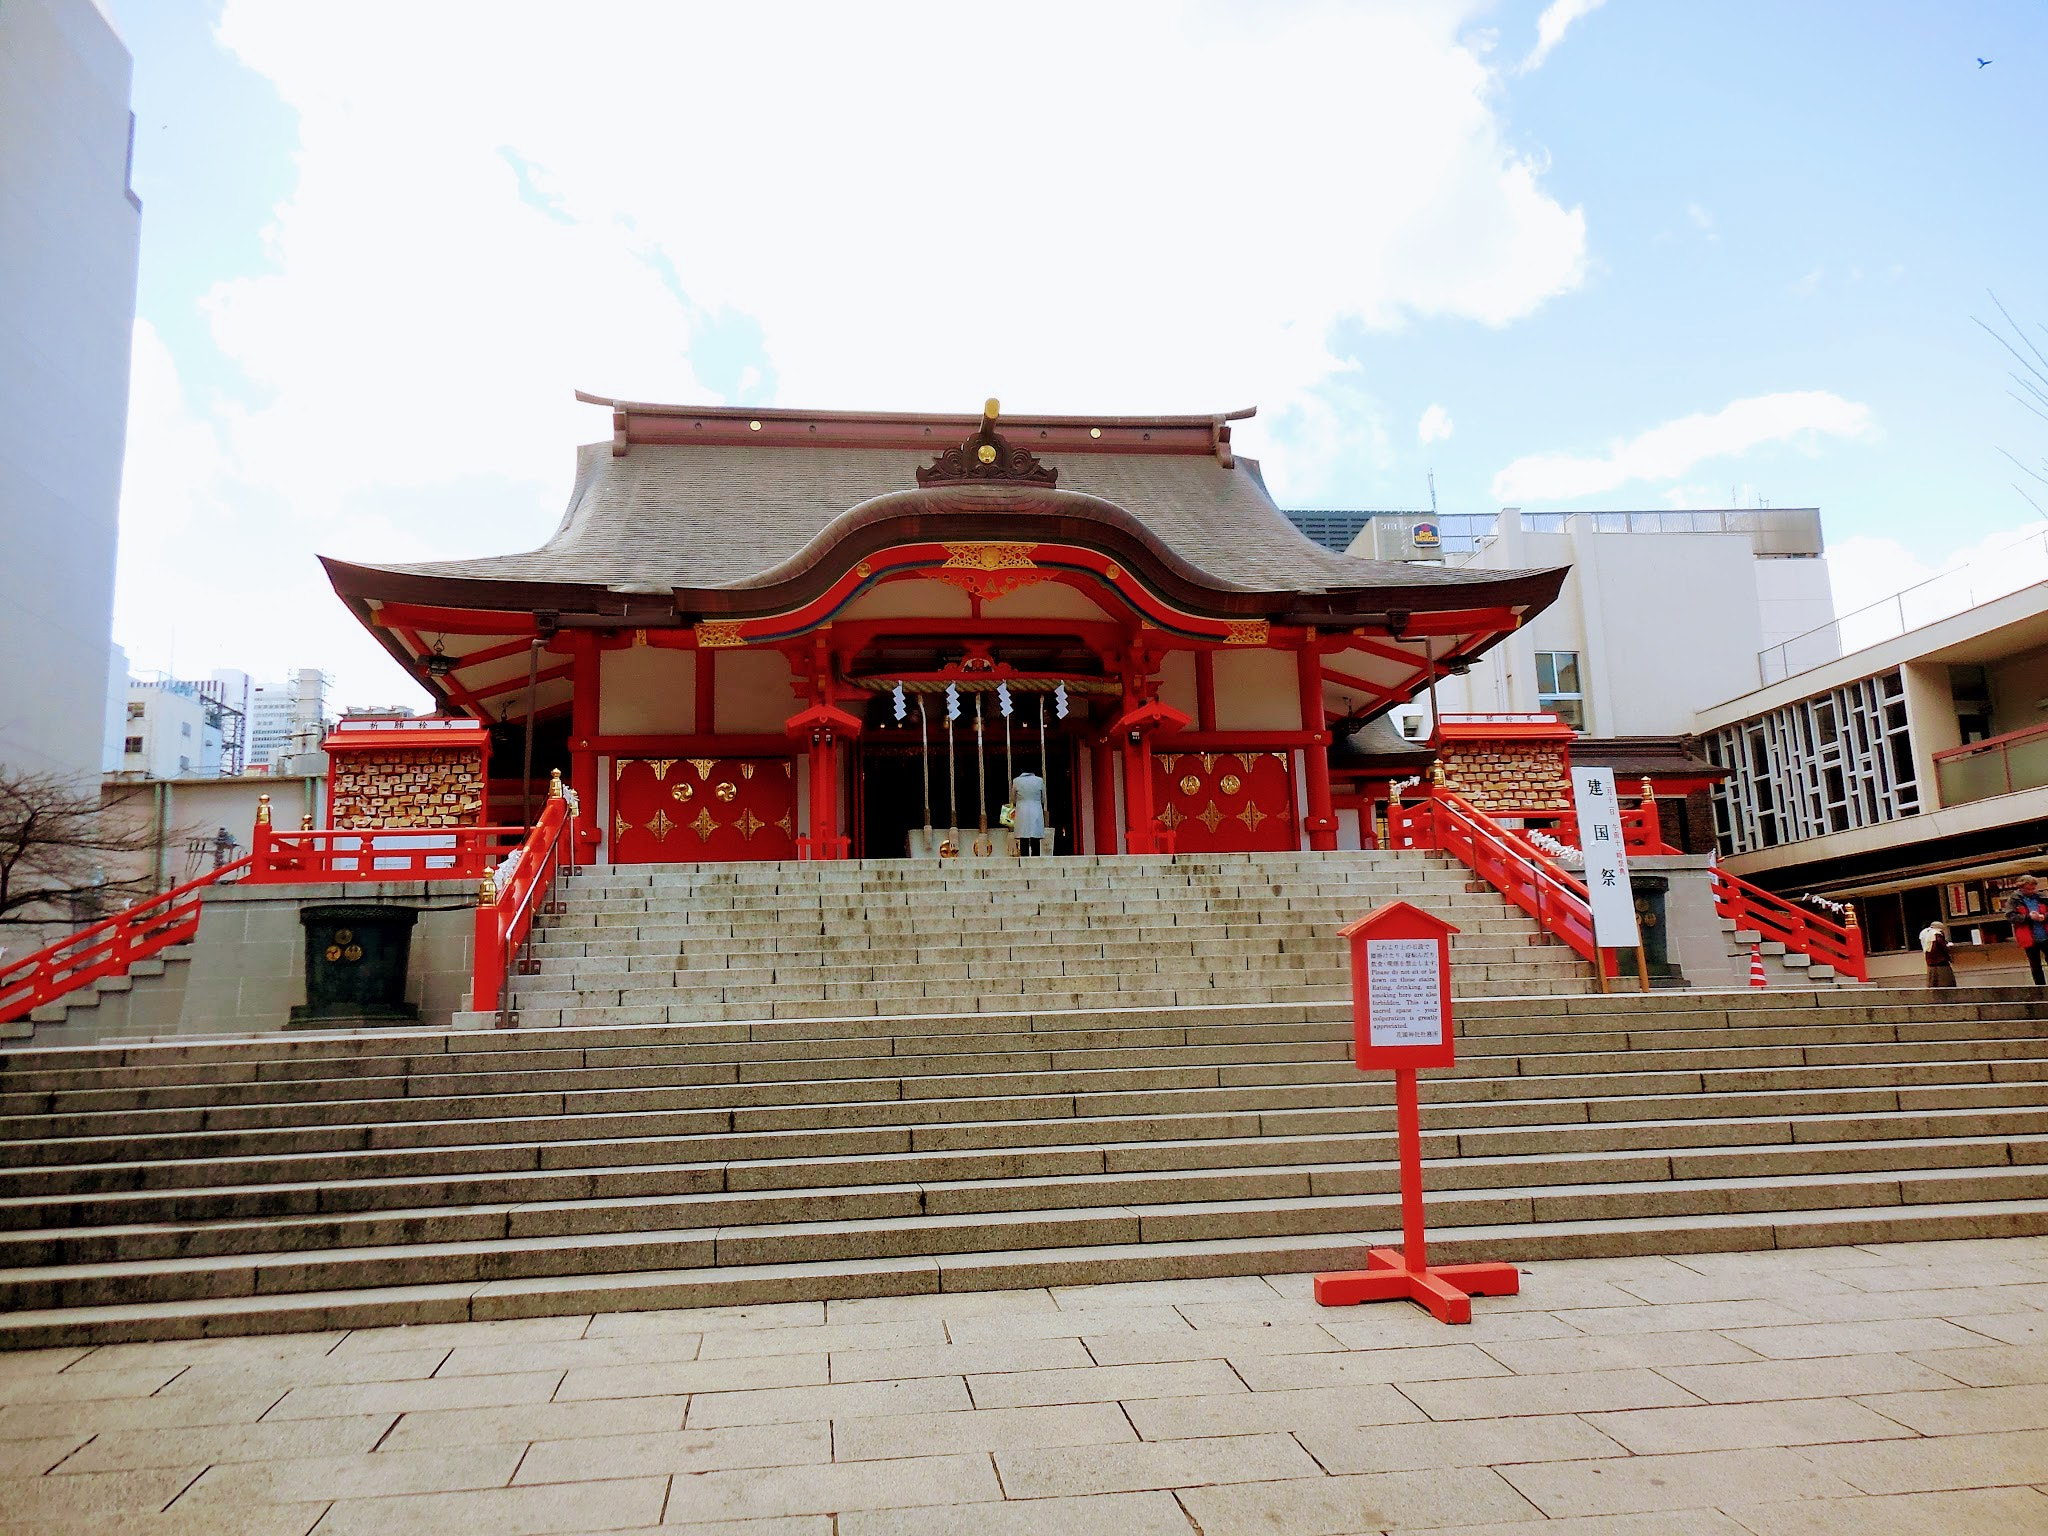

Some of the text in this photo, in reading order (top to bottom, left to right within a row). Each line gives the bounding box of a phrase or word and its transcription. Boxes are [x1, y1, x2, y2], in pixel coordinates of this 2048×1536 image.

[1587, 778, 1616, 887] 建国祭
[1417, 1014, 1438, 1022] greatly
